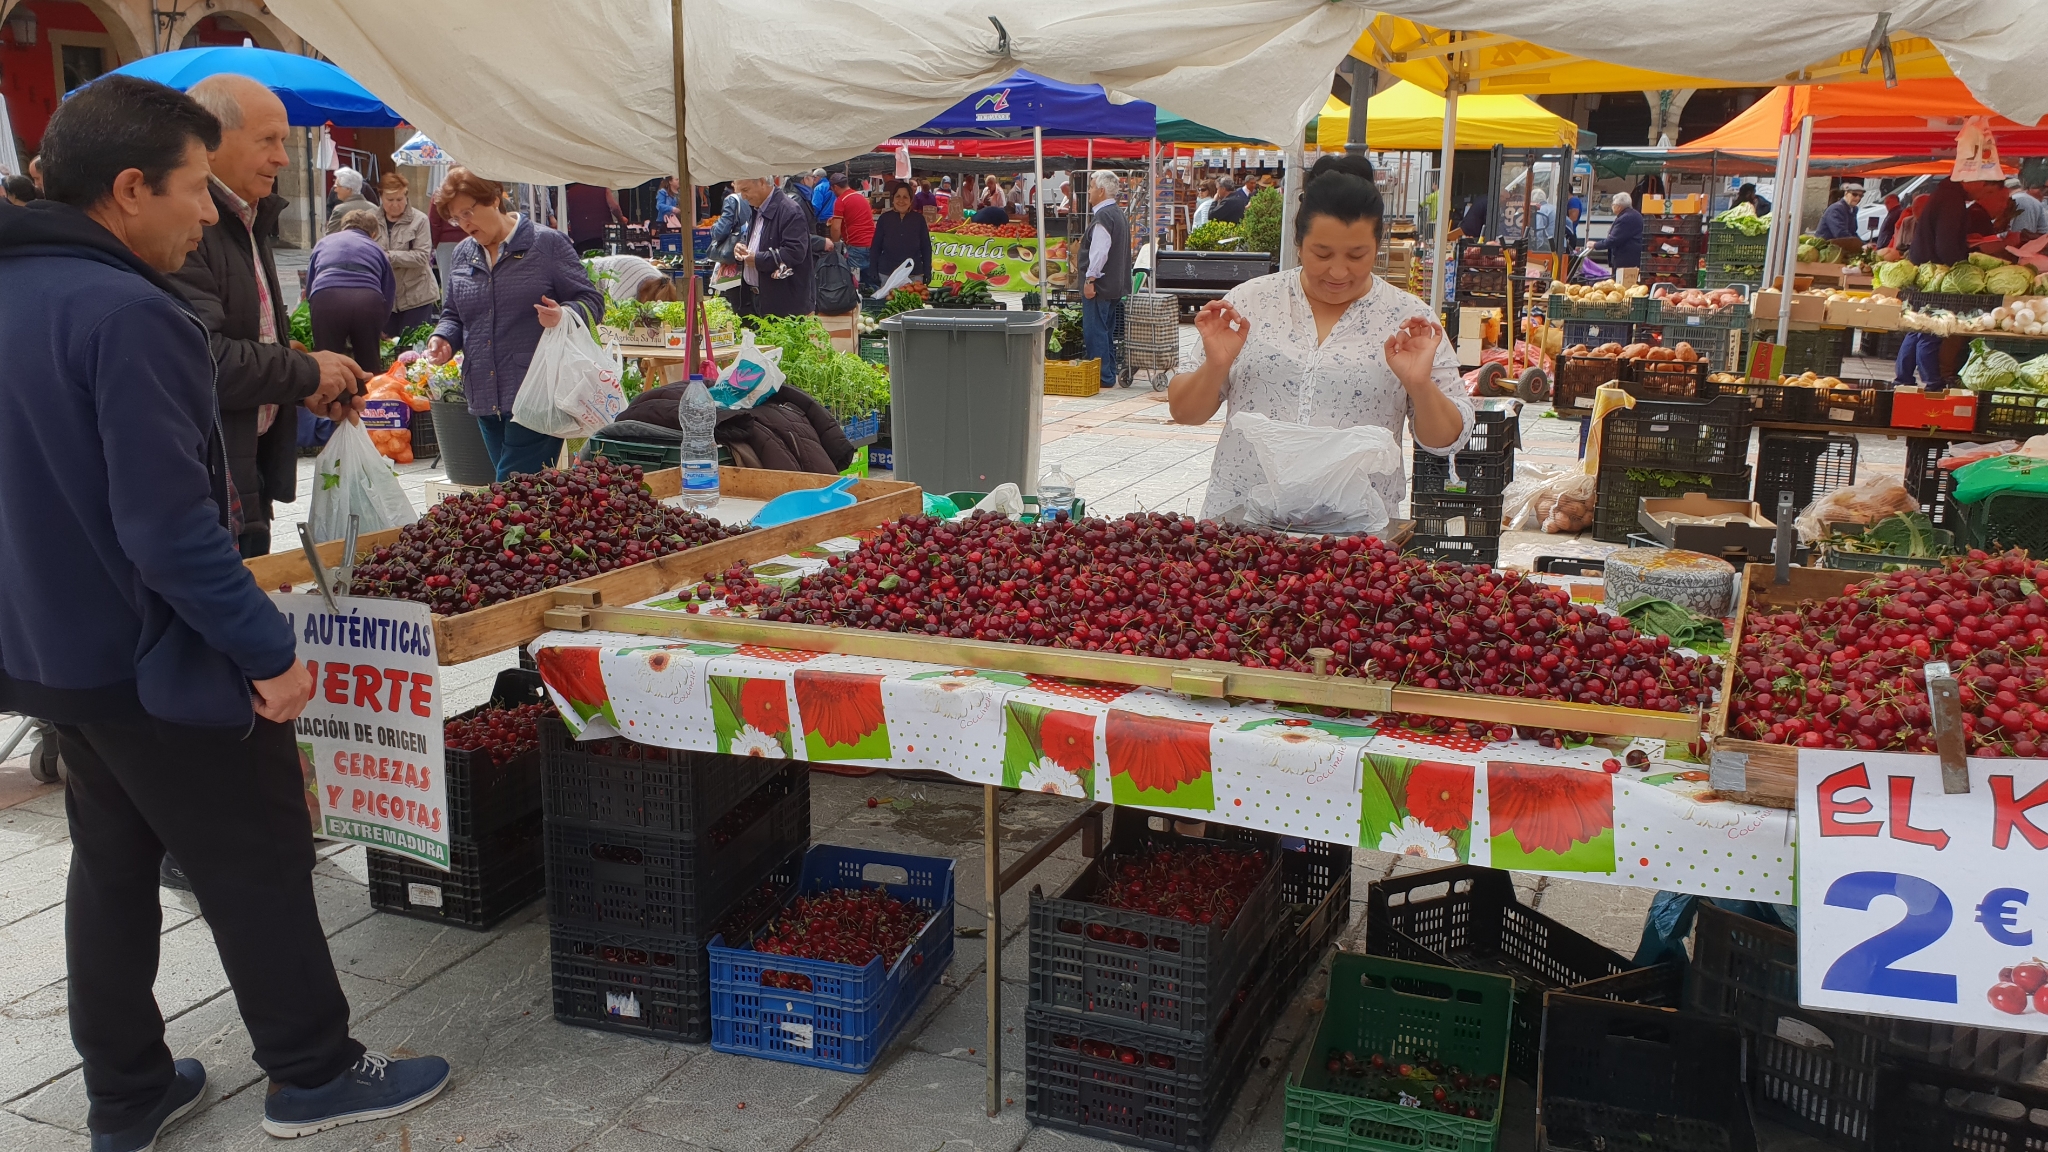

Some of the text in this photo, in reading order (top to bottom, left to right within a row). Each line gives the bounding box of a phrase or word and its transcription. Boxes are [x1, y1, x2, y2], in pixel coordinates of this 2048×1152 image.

[304, 607, 431, 657] AUTÉNTICAS
[354, 722, 373, 744] DE
[377, 726, 427, 755] ORIGEN
[334, 750, 431, 792] CEREZAS
[326, 784, 442, 833] Y PICOTAS
[1816, 762, 1951, 852] EL
[329, 818, 445, 861] EXTREMADURA
[1821, 870, 2033, 1004] 2 €
